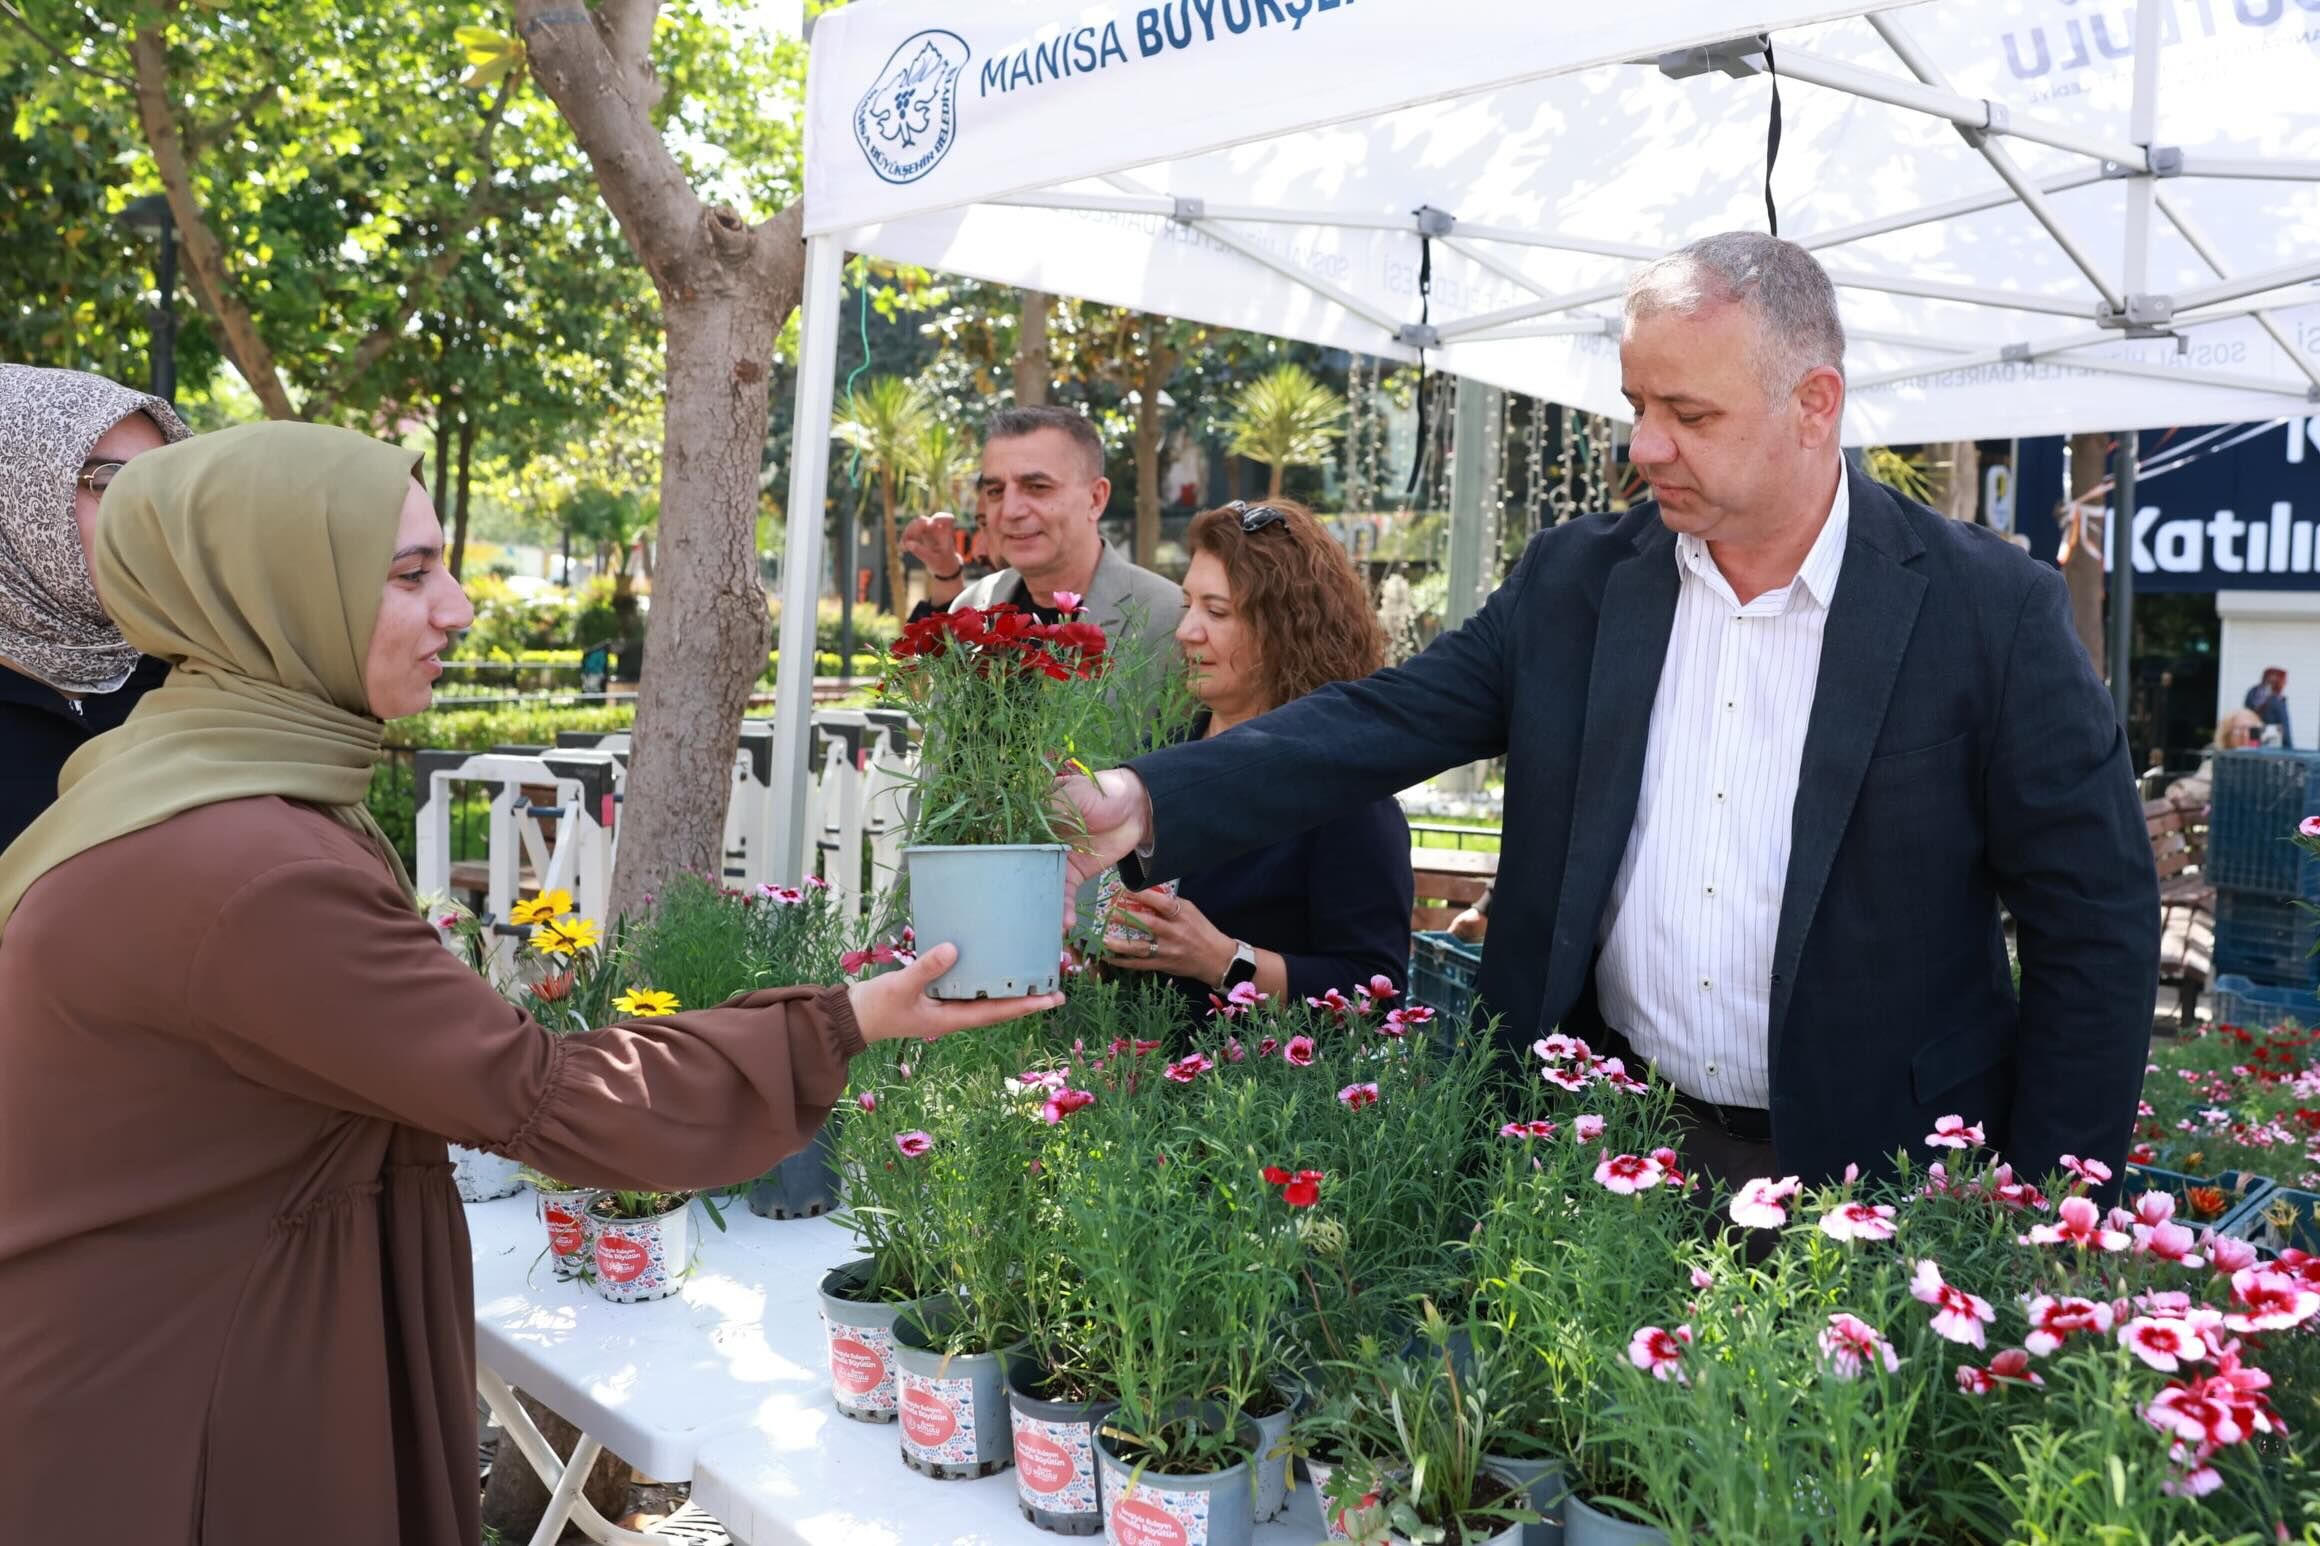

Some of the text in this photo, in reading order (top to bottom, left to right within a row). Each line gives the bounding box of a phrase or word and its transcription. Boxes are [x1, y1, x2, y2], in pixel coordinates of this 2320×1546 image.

[980, 0, 1355, 97] MANİSA BÜYÜK
[2104, 501, 2320, 573] Katılı
